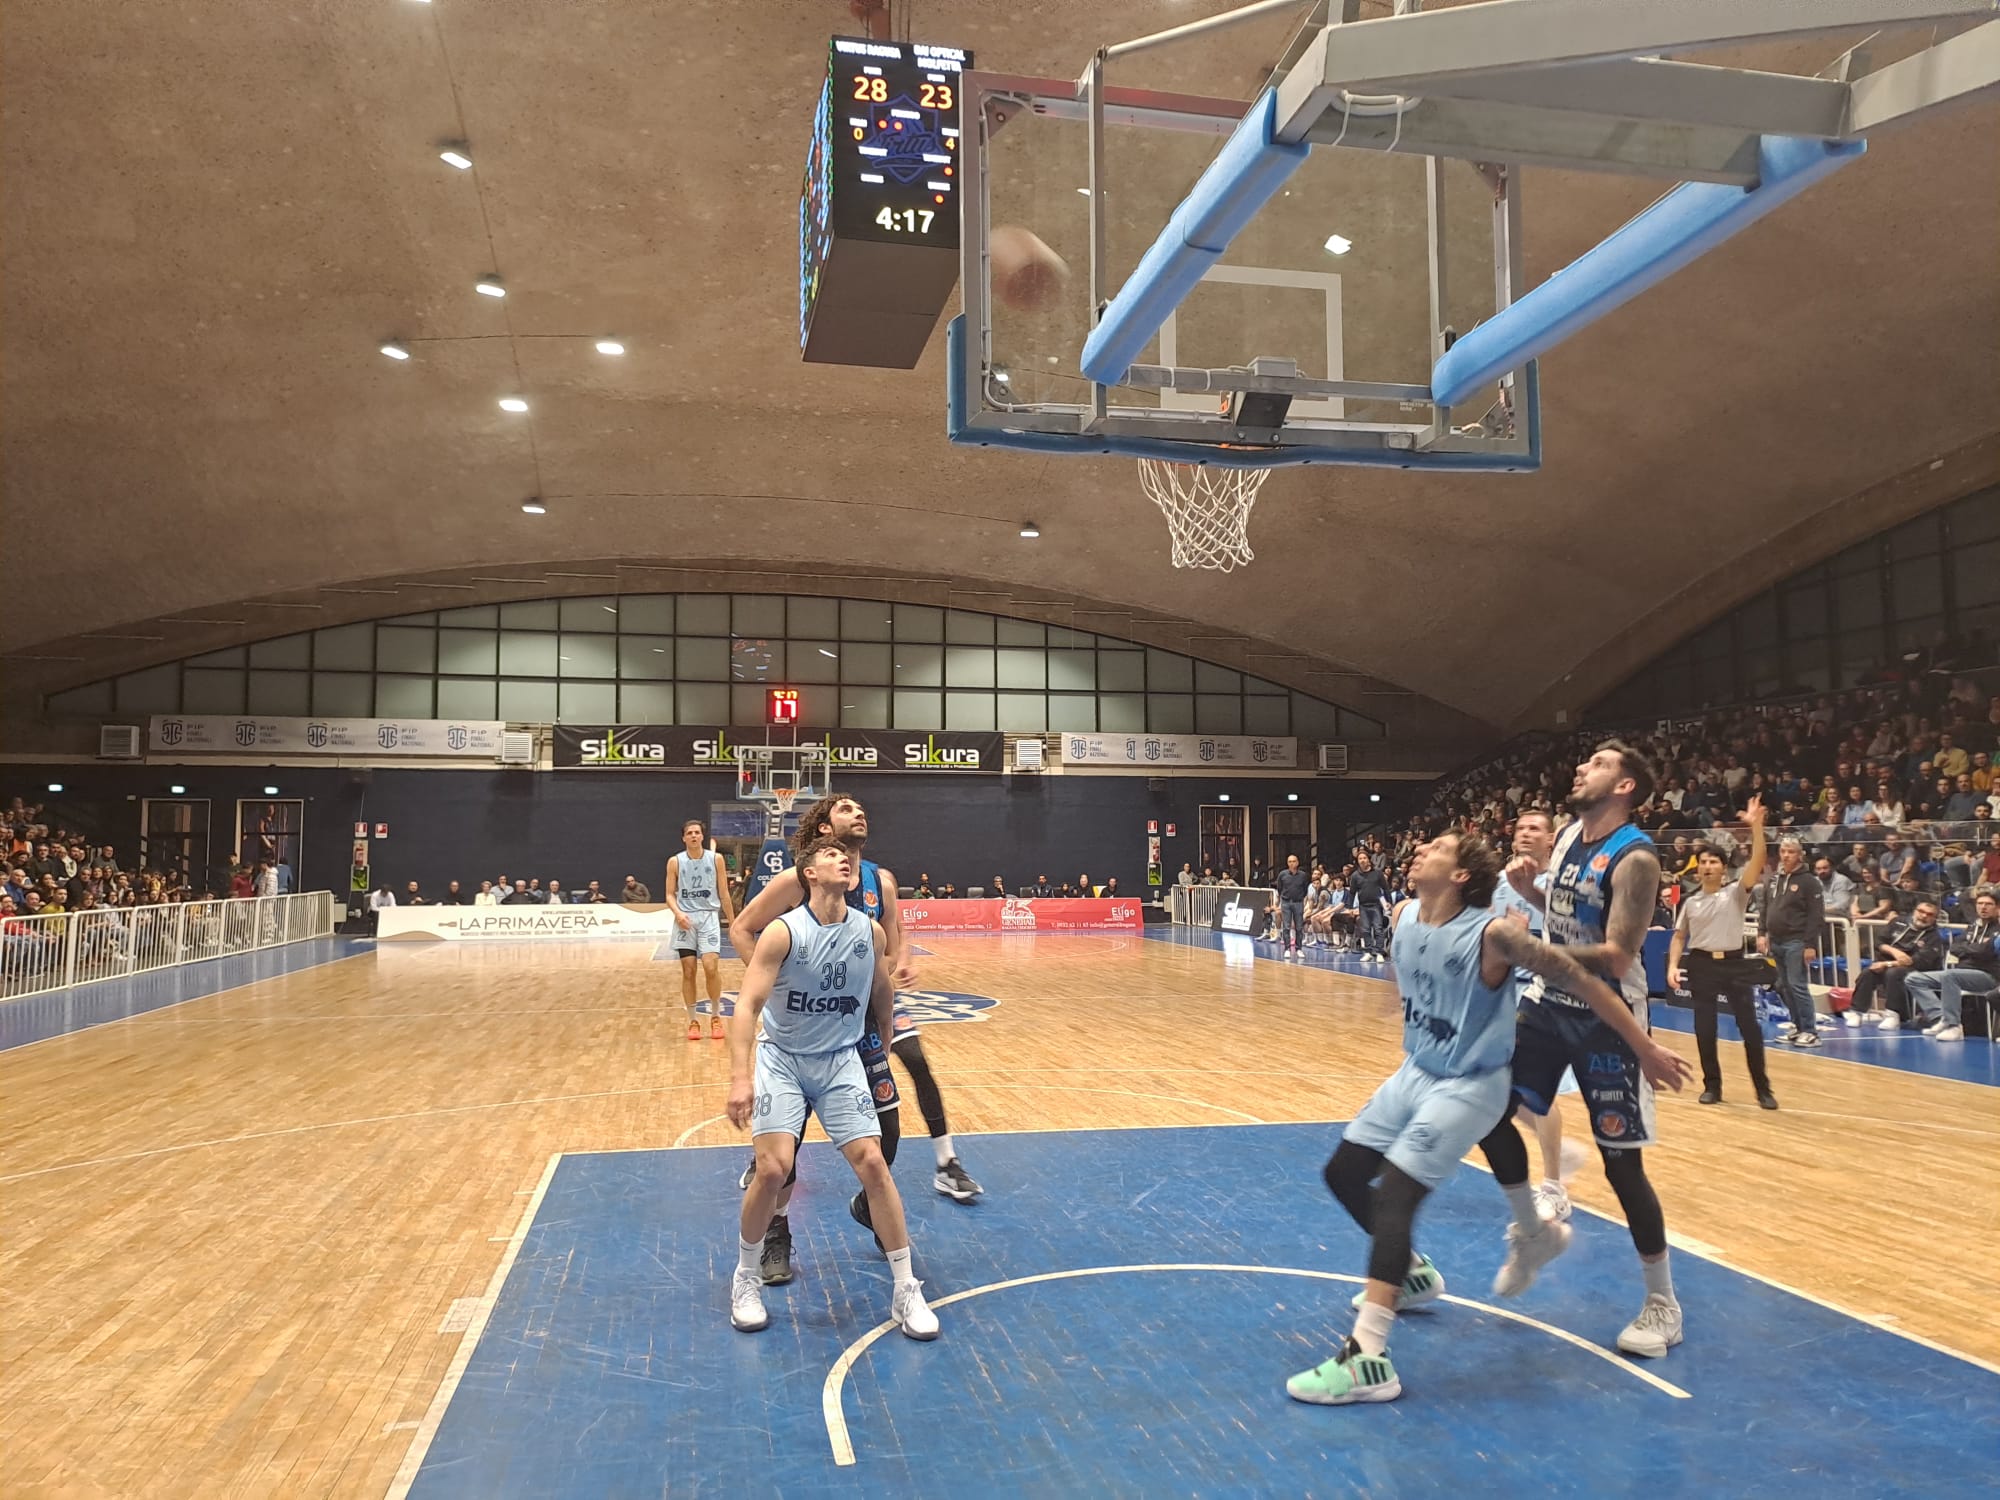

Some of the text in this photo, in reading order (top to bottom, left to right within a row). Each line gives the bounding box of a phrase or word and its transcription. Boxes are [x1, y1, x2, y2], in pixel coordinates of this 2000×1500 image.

[853, 75, 888, 102] 28
[919, 83, 953, 109] 23
[853, 127, 864, 141] 0
[945, 137, 955, 150] 4
[876, 206, 935, 234] 4:17
[775, 700, 797, 718] 17
[580, 729, 665, 760] Sikura
[904, 734, 980, 763] Sikura
[691, 876, 703, 889] 22
[902, 904, 928, 920] Eligo
[1111, 903, 1136, 918] Eligo
[819, 960, 847, 991] 38
[786, 990, 841, 1013] Ekso
[1588, 1053, 1622, 1073] AB
